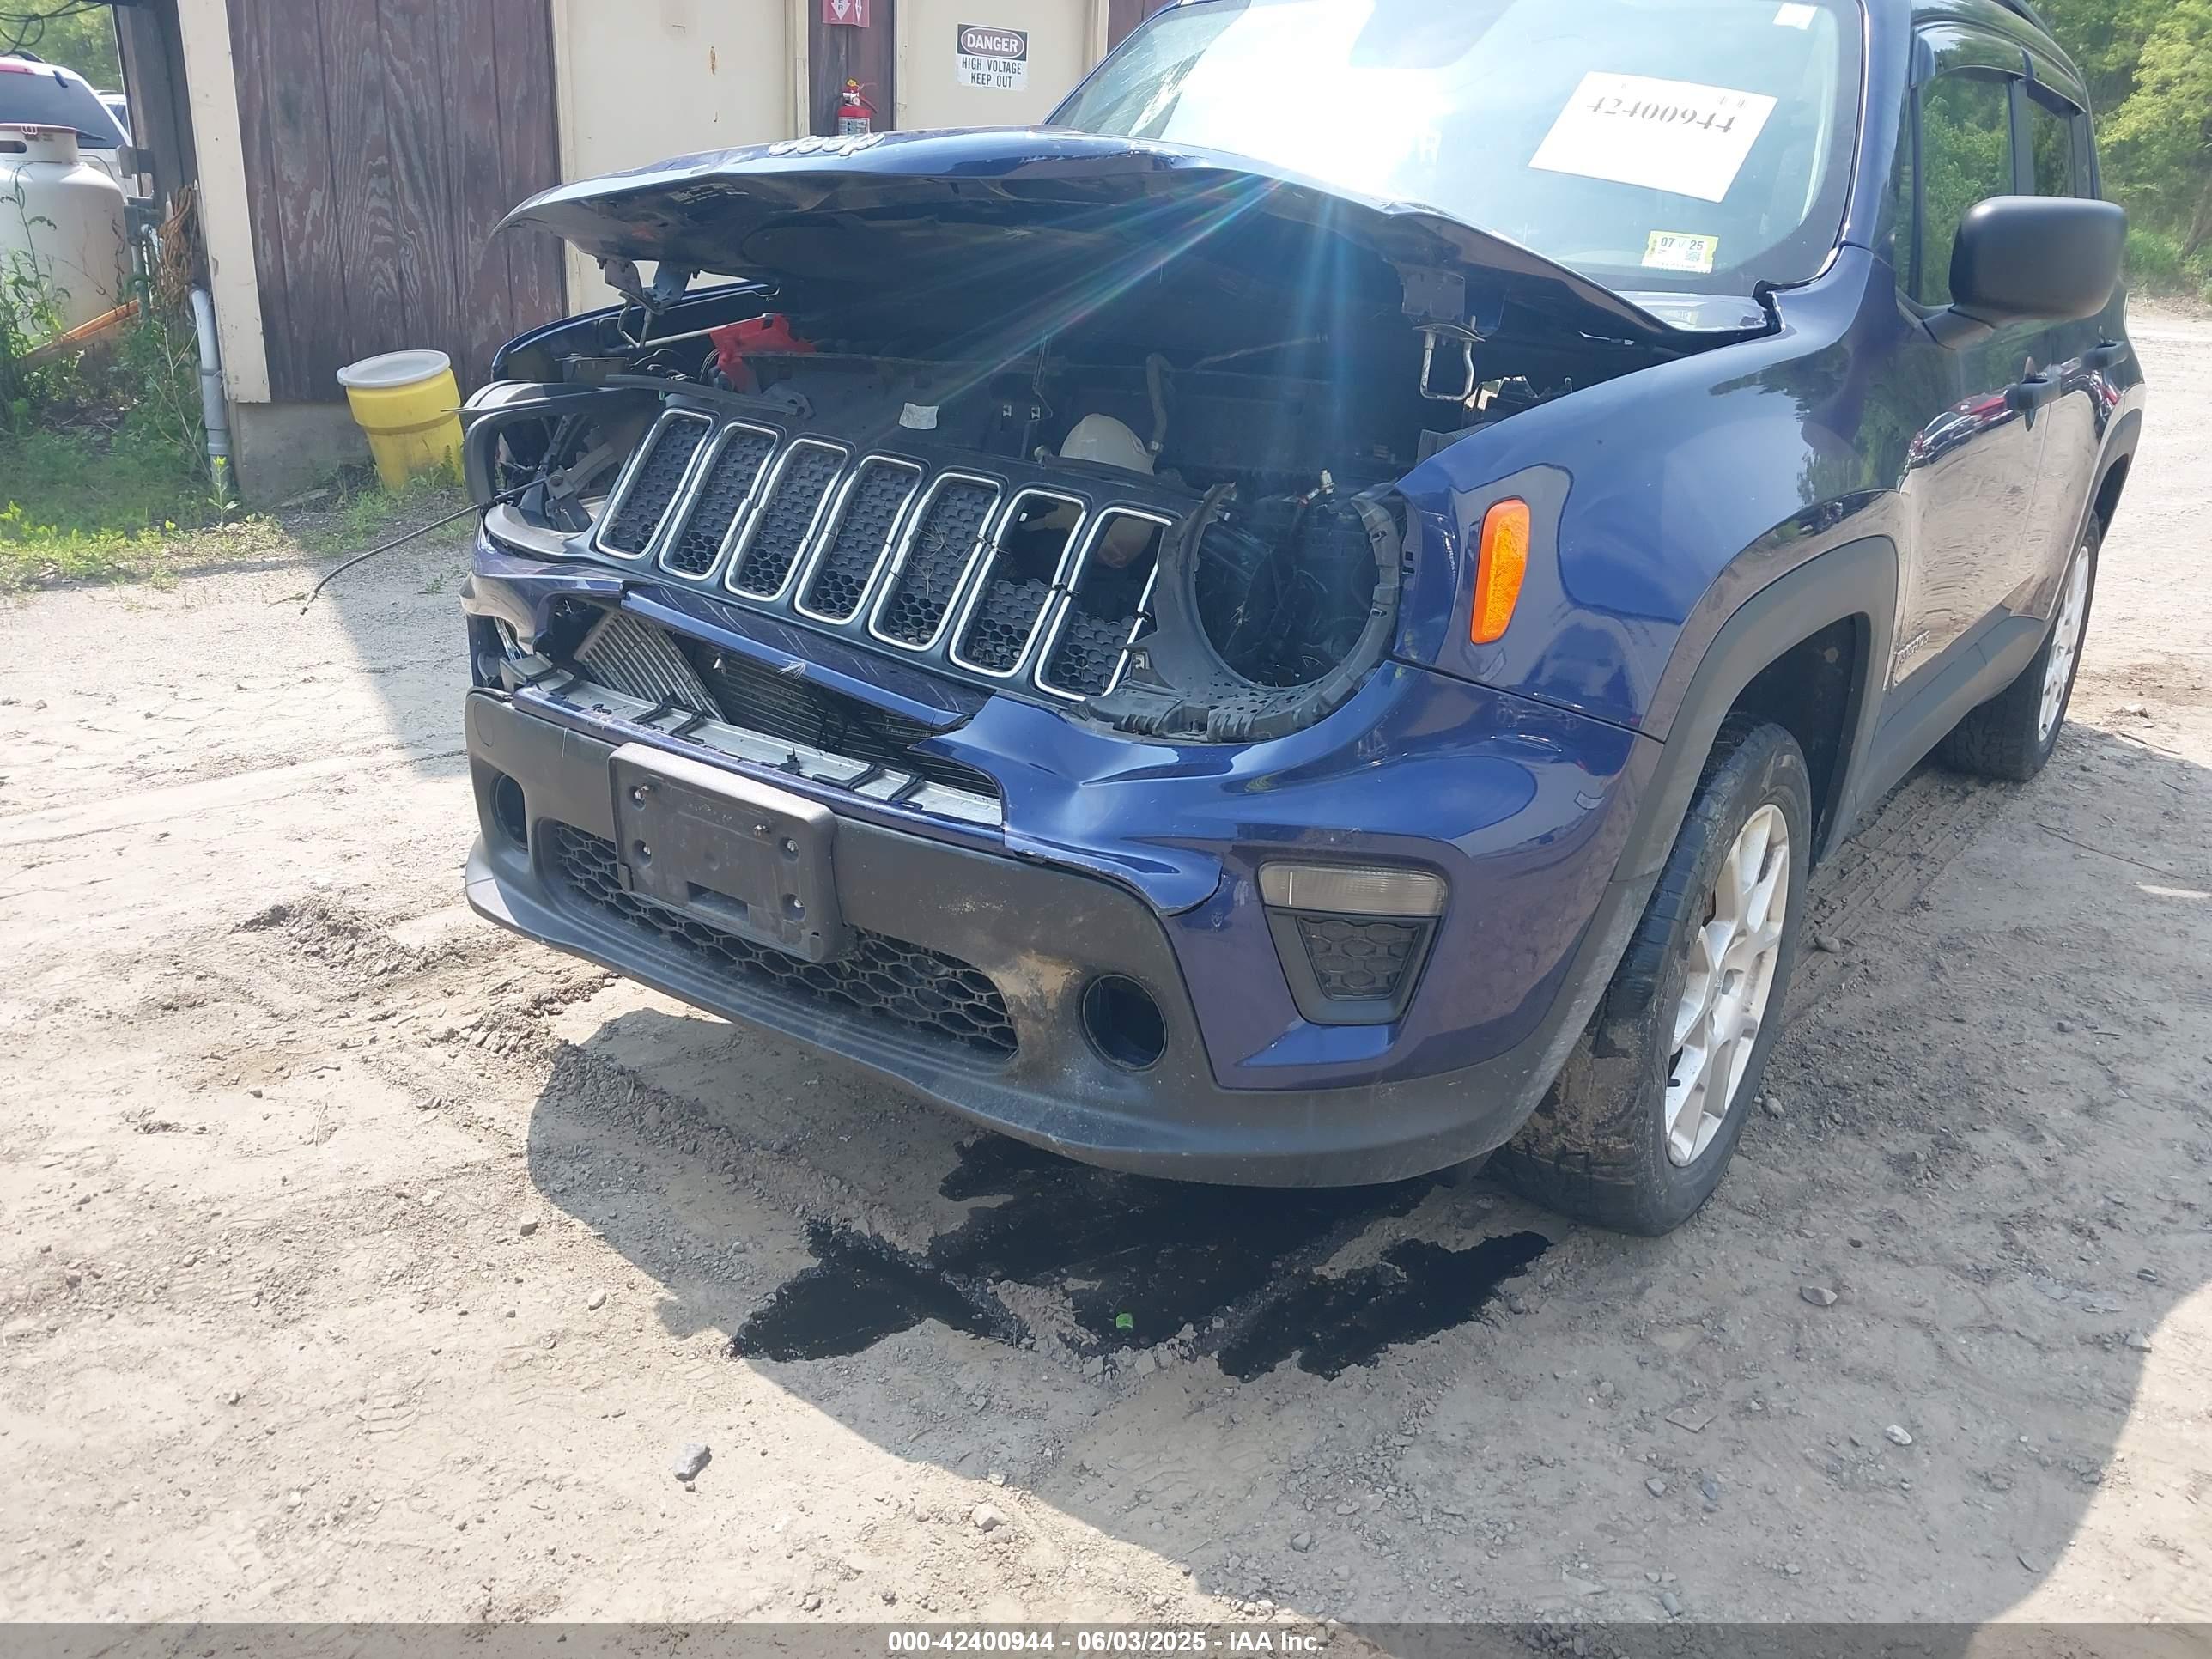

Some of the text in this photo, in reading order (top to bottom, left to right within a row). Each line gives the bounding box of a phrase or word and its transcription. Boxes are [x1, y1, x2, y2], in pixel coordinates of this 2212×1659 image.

[967, 33, 1018, 52] DANGER
[962, 57, 1022, 75] HIGH VOLTAGE
[970, 72, 1012, 88] KEEP OUT
[1661, 237, 1705, 251] 07 25
